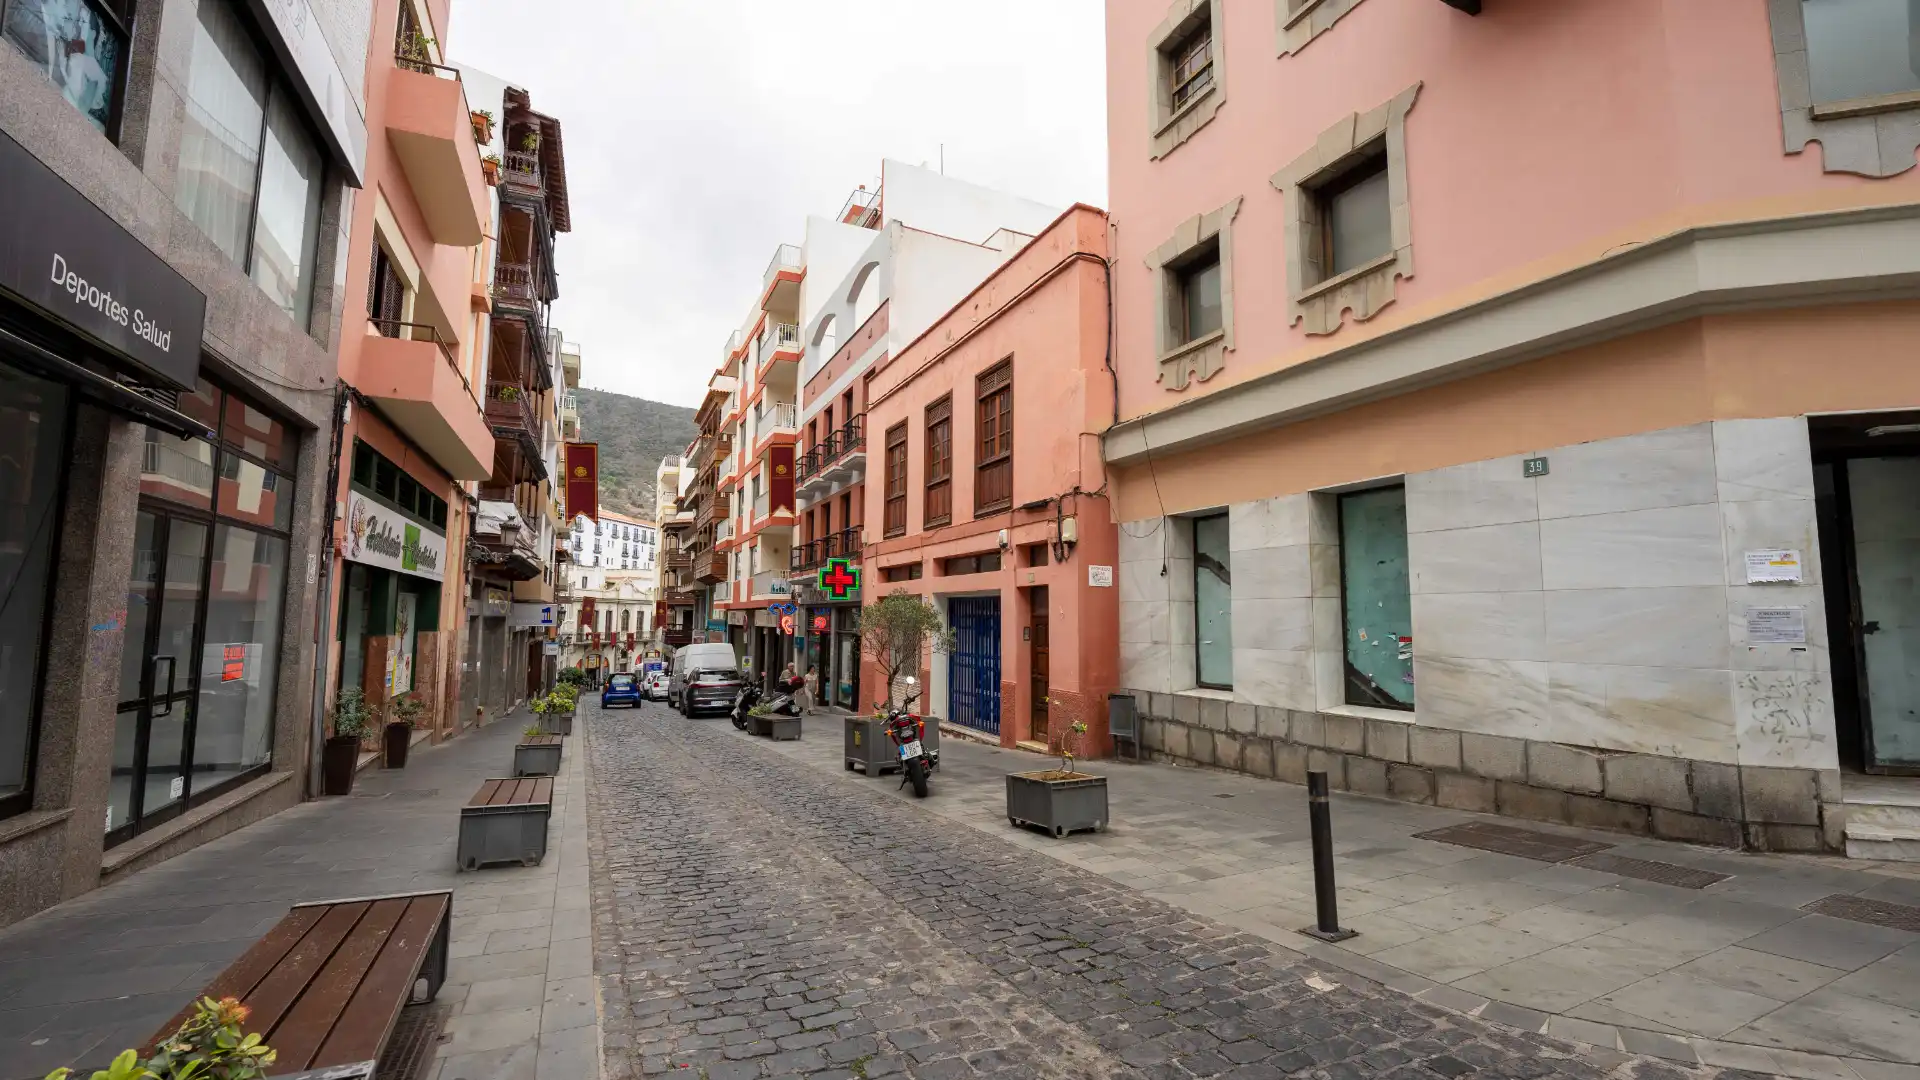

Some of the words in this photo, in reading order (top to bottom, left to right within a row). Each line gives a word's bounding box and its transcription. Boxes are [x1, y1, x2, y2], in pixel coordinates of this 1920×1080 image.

[51, 253, 129, 327] Deportes
[132, 308, 172, 353] Salud
[1529, 461, 1542, 473] 39
